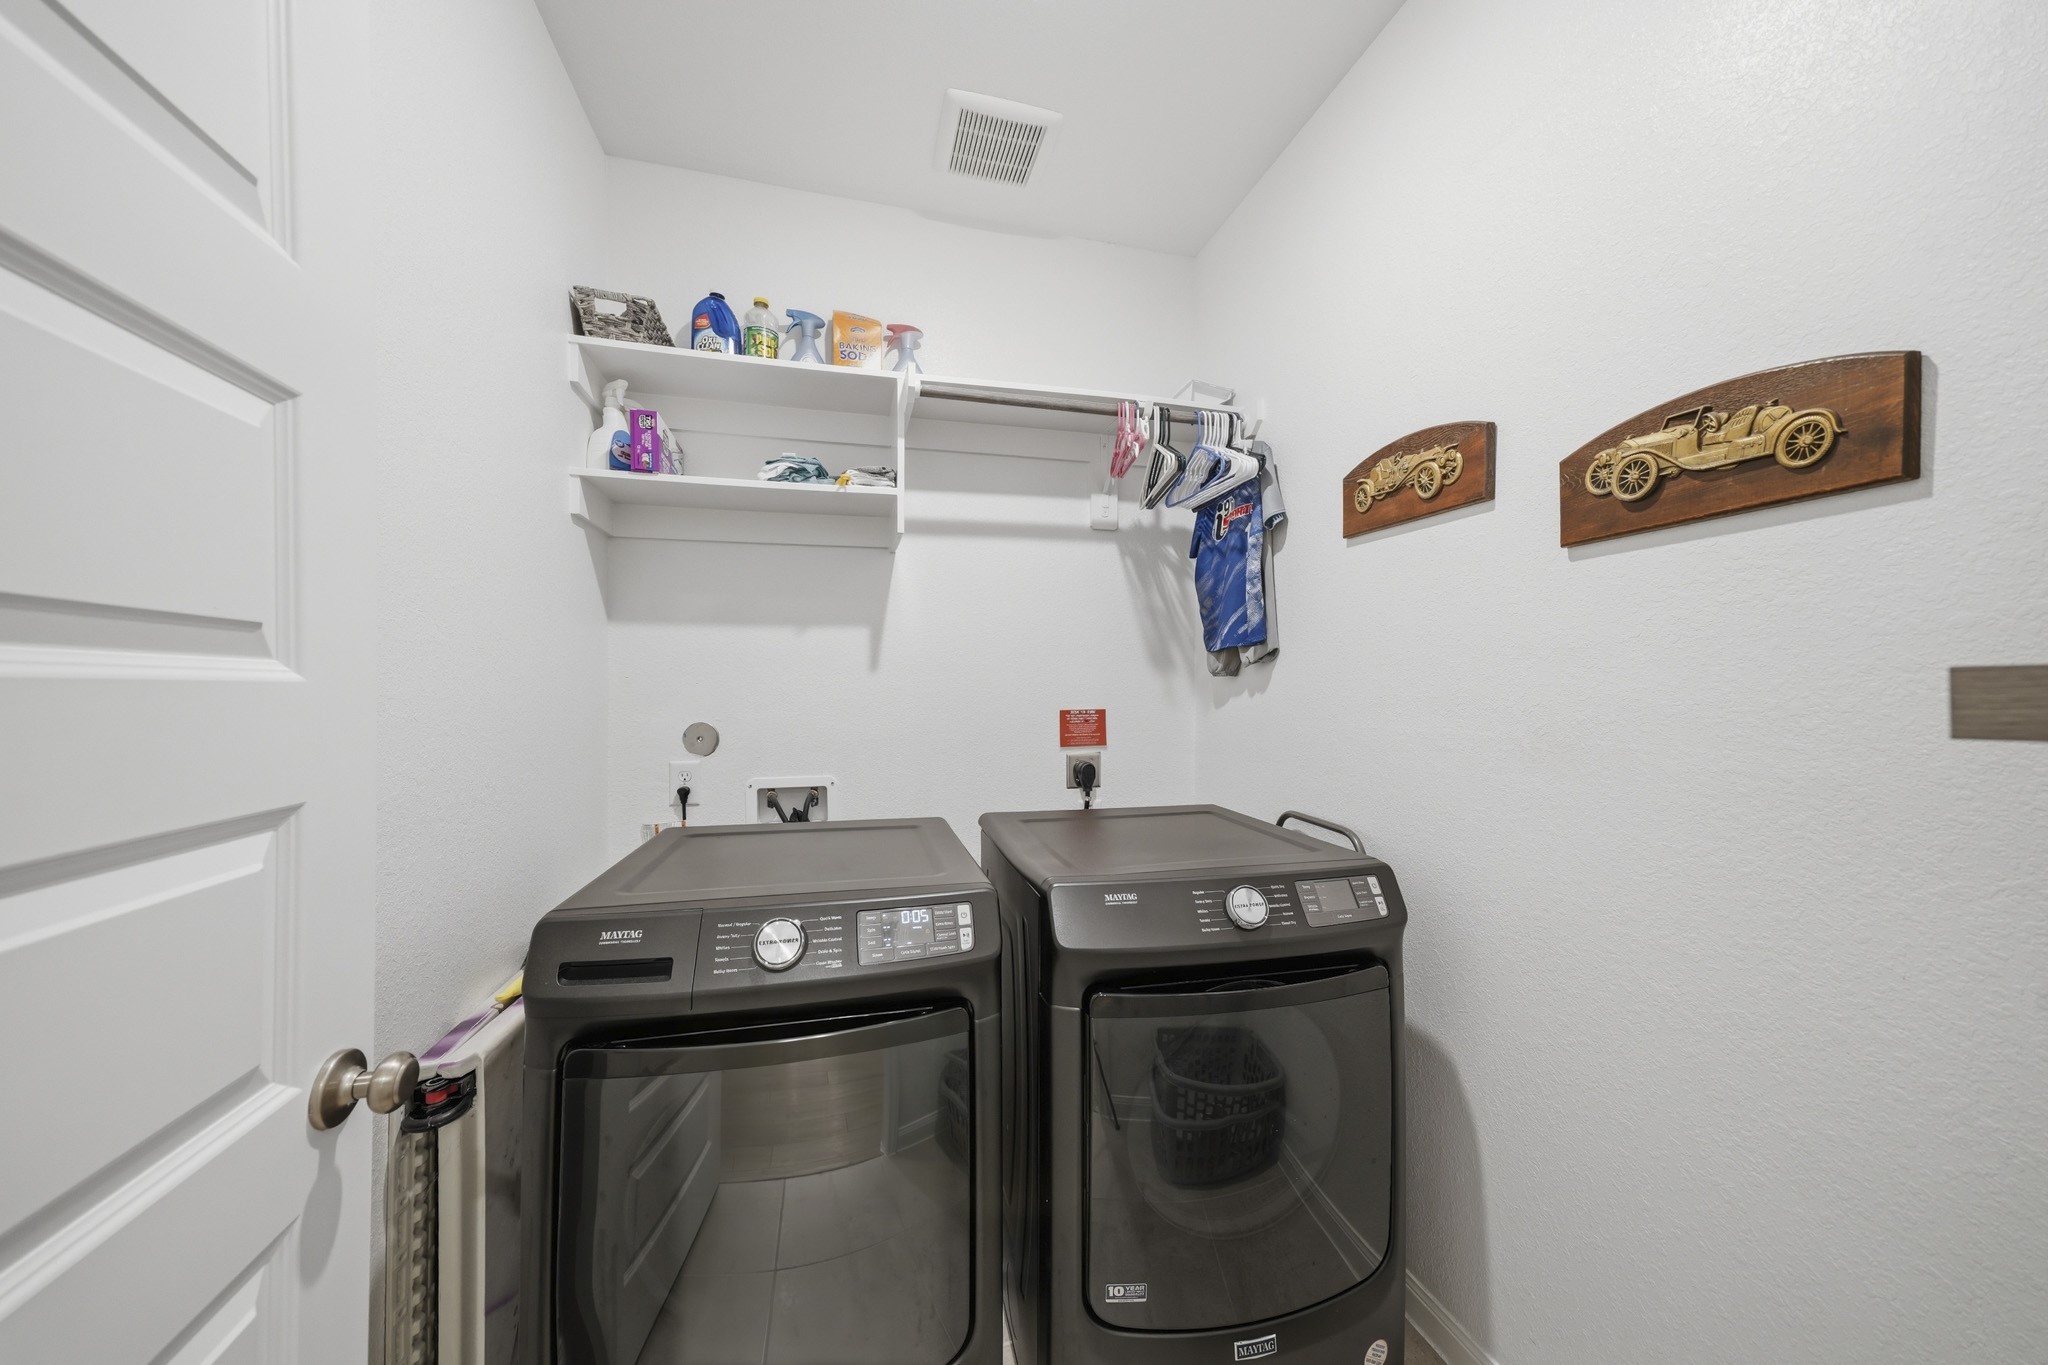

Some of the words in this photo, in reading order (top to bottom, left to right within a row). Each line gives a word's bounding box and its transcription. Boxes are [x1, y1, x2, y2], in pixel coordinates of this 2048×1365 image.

[839, 341, 877, 353] BAKING
[840, 350, 873, 361] SOD
[1104, 892, 1138, 901] MAYTAG
[901, 909, 929, 924] 0:05
[600, 929, 643, 940] MAYTAG
[1108, 1286, 1125, 1297] 10
[1238, 1340, 1275, 1357] MAYTAG
